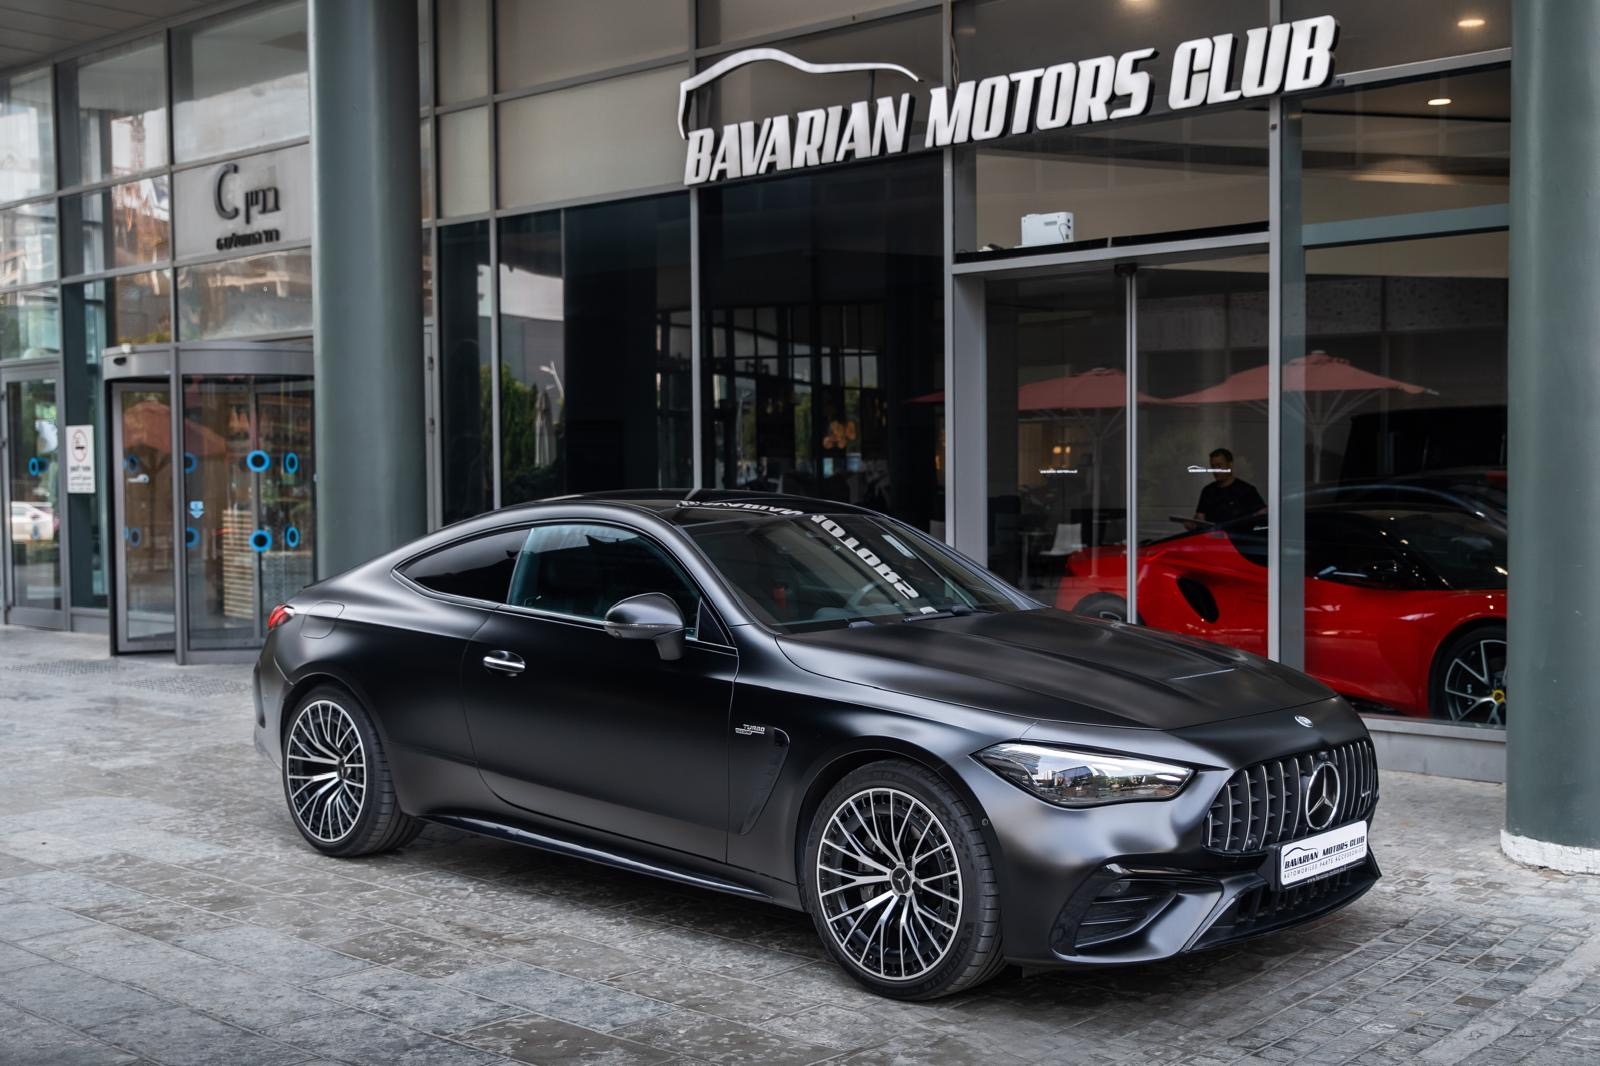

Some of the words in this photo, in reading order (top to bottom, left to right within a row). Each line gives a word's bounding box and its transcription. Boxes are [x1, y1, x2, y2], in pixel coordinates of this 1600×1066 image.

[683, 93, 912, 186] BAVARIAN
[924, 48, 1158, 148] MOTORS
[1168, 15, 1337, 109] CLUB
[213, 163, 239, 219] C
[1284, 851, 1318, 869] BAVARIAN
[1322, 842, 1348, 856] MOTORS
[1349, 836, 1365, 847] CLUB
